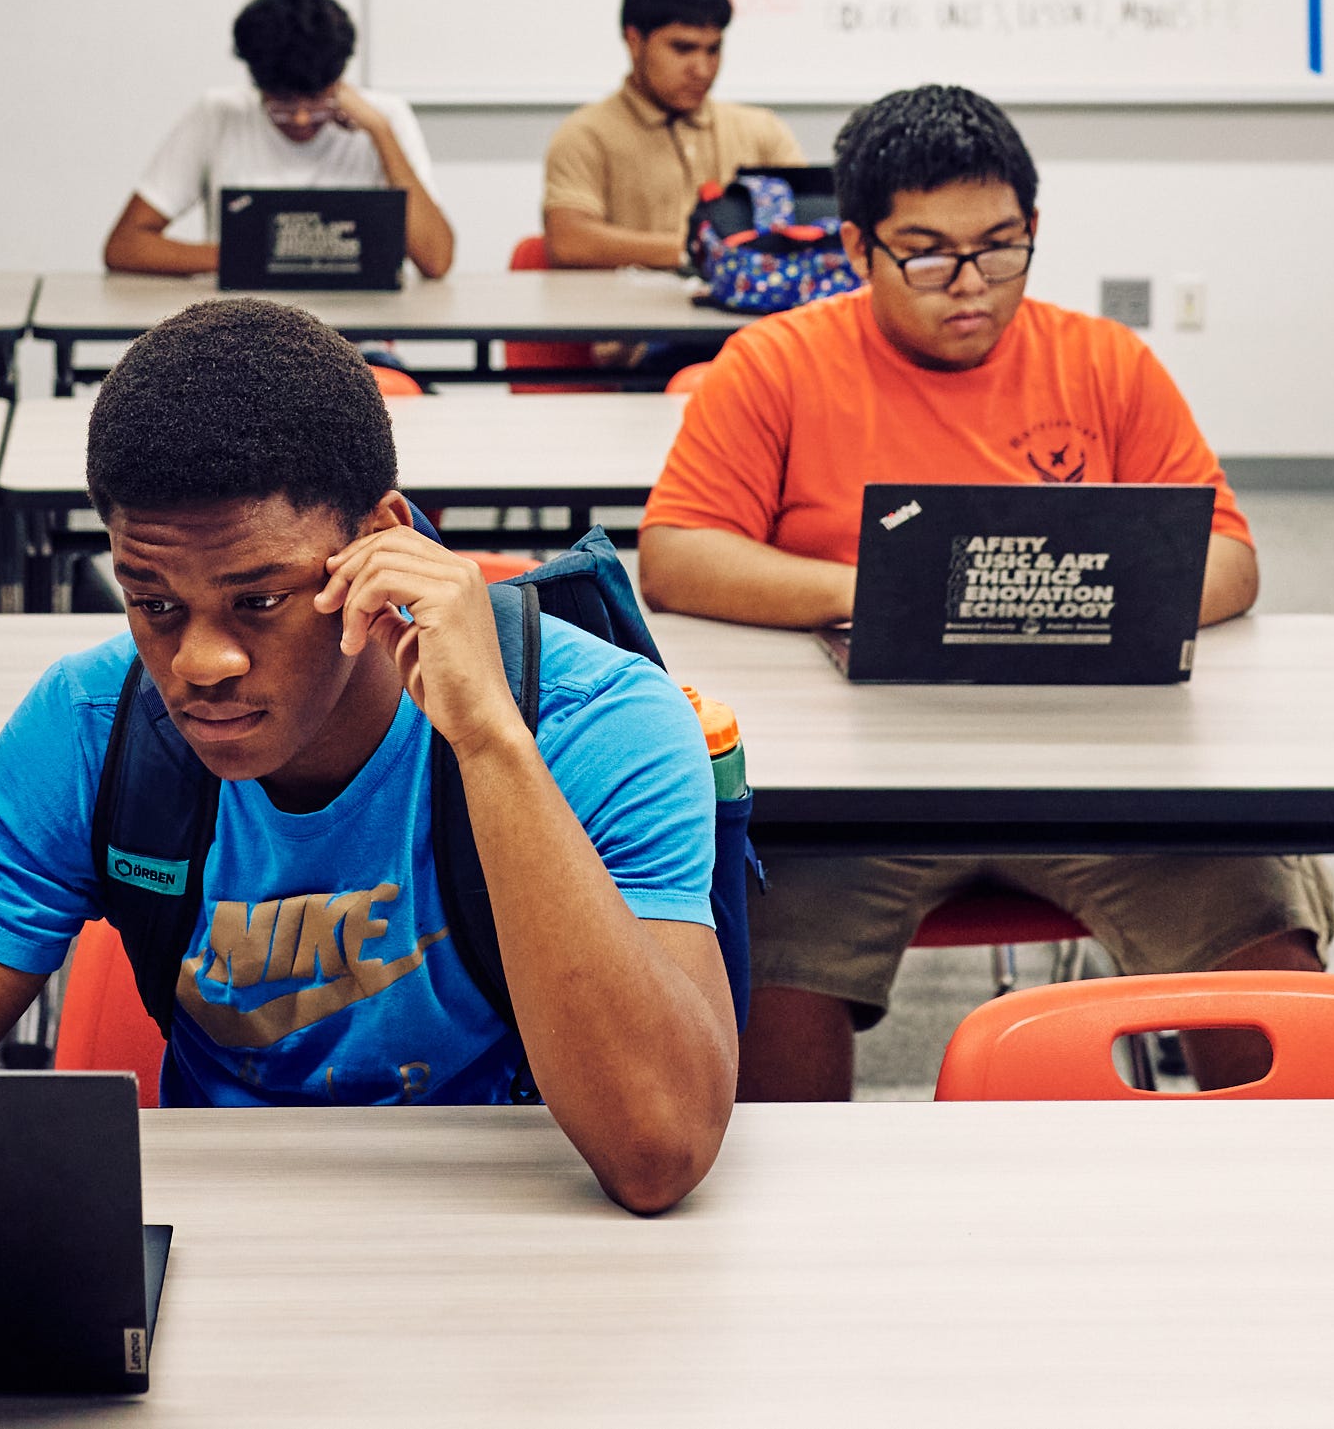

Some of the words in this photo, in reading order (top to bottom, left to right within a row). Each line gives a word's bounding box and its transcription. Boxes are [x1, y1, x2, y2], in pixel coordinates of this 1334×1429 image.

[1058, 552, 1110, 570] ART
[133, 864, 176, 885] ÖRBEN
[206, 883, 401, 988] NIKE
